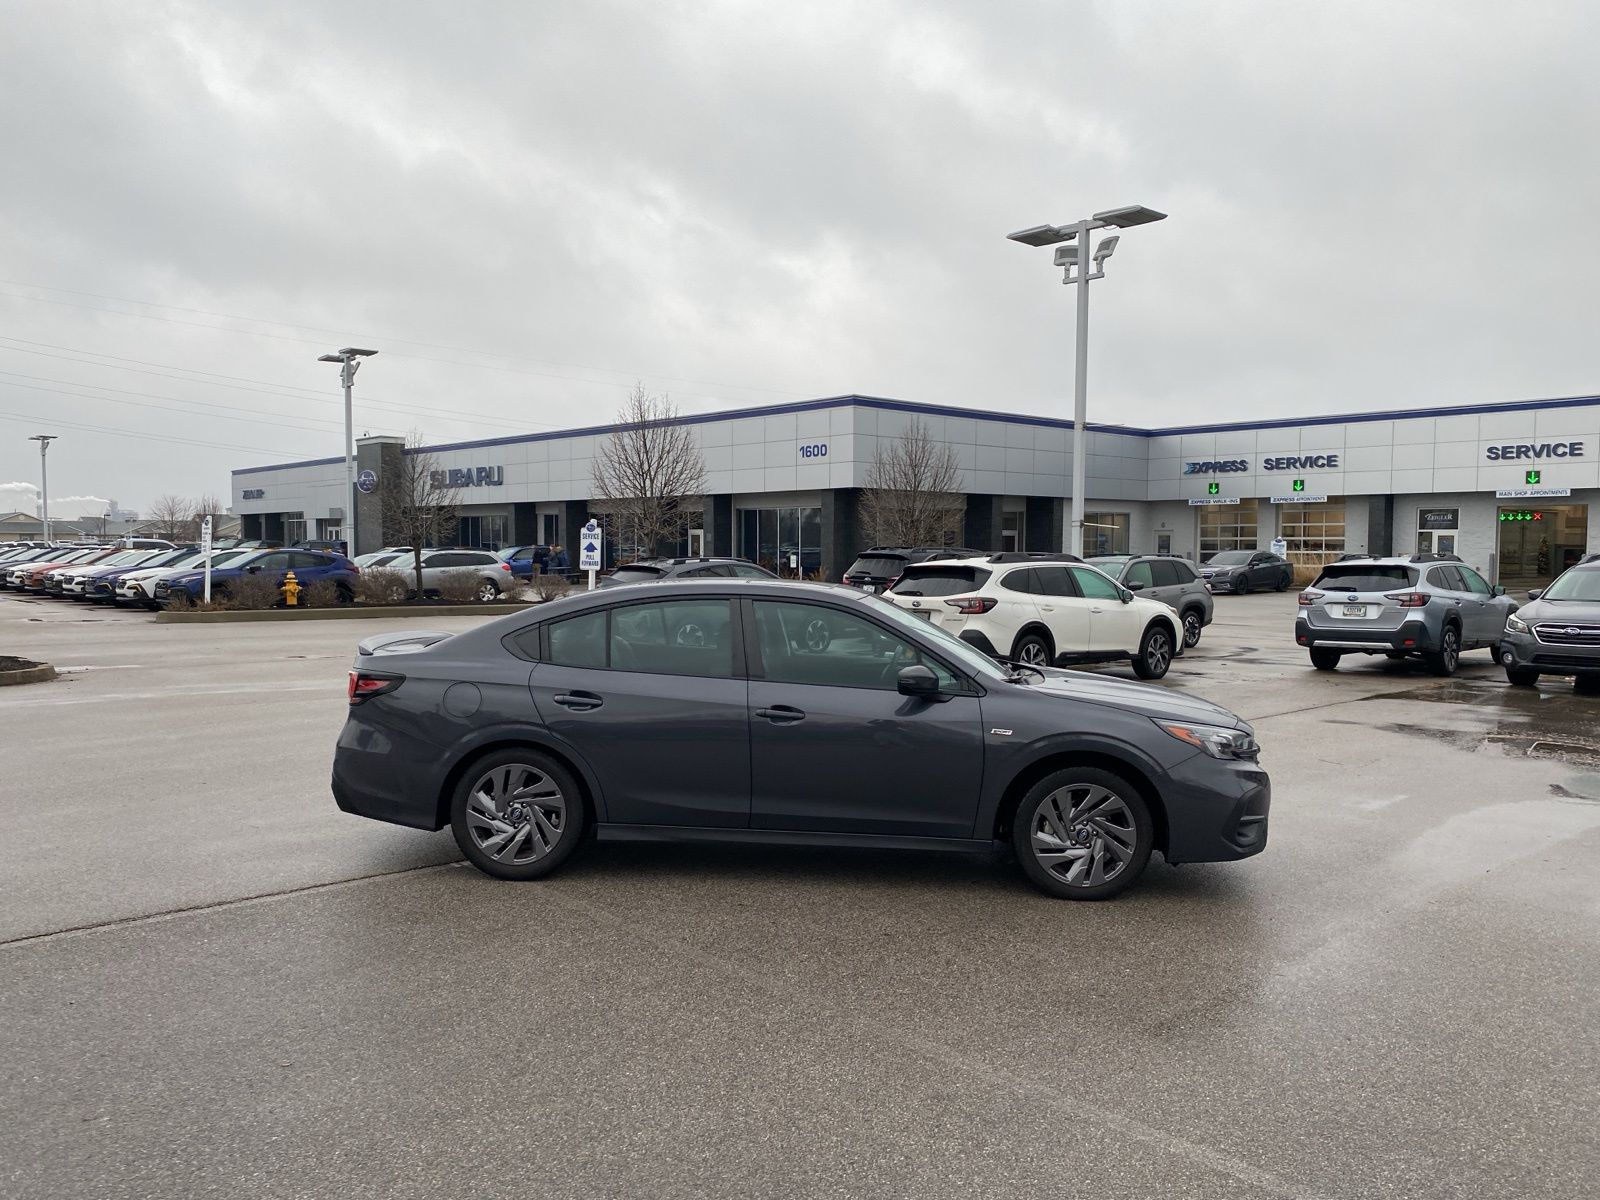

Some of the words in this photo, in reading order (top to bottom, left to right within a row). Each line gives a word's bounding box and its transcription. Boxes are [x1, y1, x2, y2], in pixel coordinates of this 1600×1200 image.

[799, 443, 828, 458] 1600
[1486, 442, 1584, 460] SERVICE
[1184, 459, 1249, 475] EXPRESS
[1263, 454, 1339, 471] SERVICE
[430, 465, 504, 490] SUBARU
[582, 532, 600, 540] SERVICE
